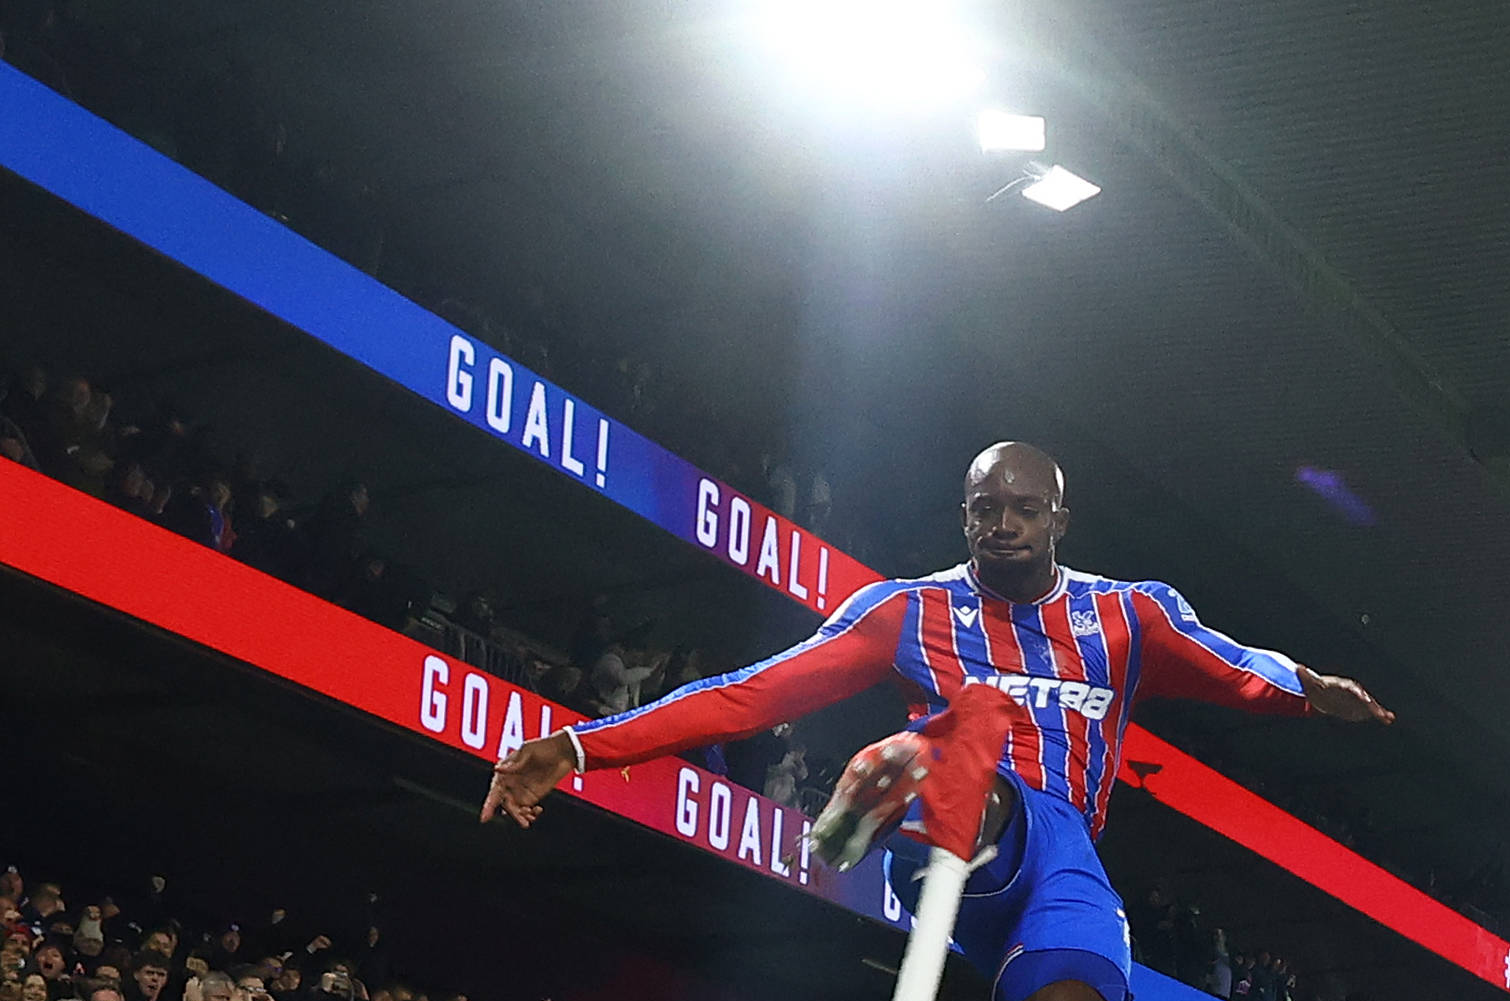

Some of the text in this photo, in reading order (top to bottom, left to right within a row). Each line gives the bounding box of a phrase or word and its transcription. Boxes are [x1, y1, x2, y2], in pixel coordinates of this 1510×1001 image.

[447, 334, 829, 610] GOAL! GOAL!
[420, 655, 811, 885] GOA GOAL!
